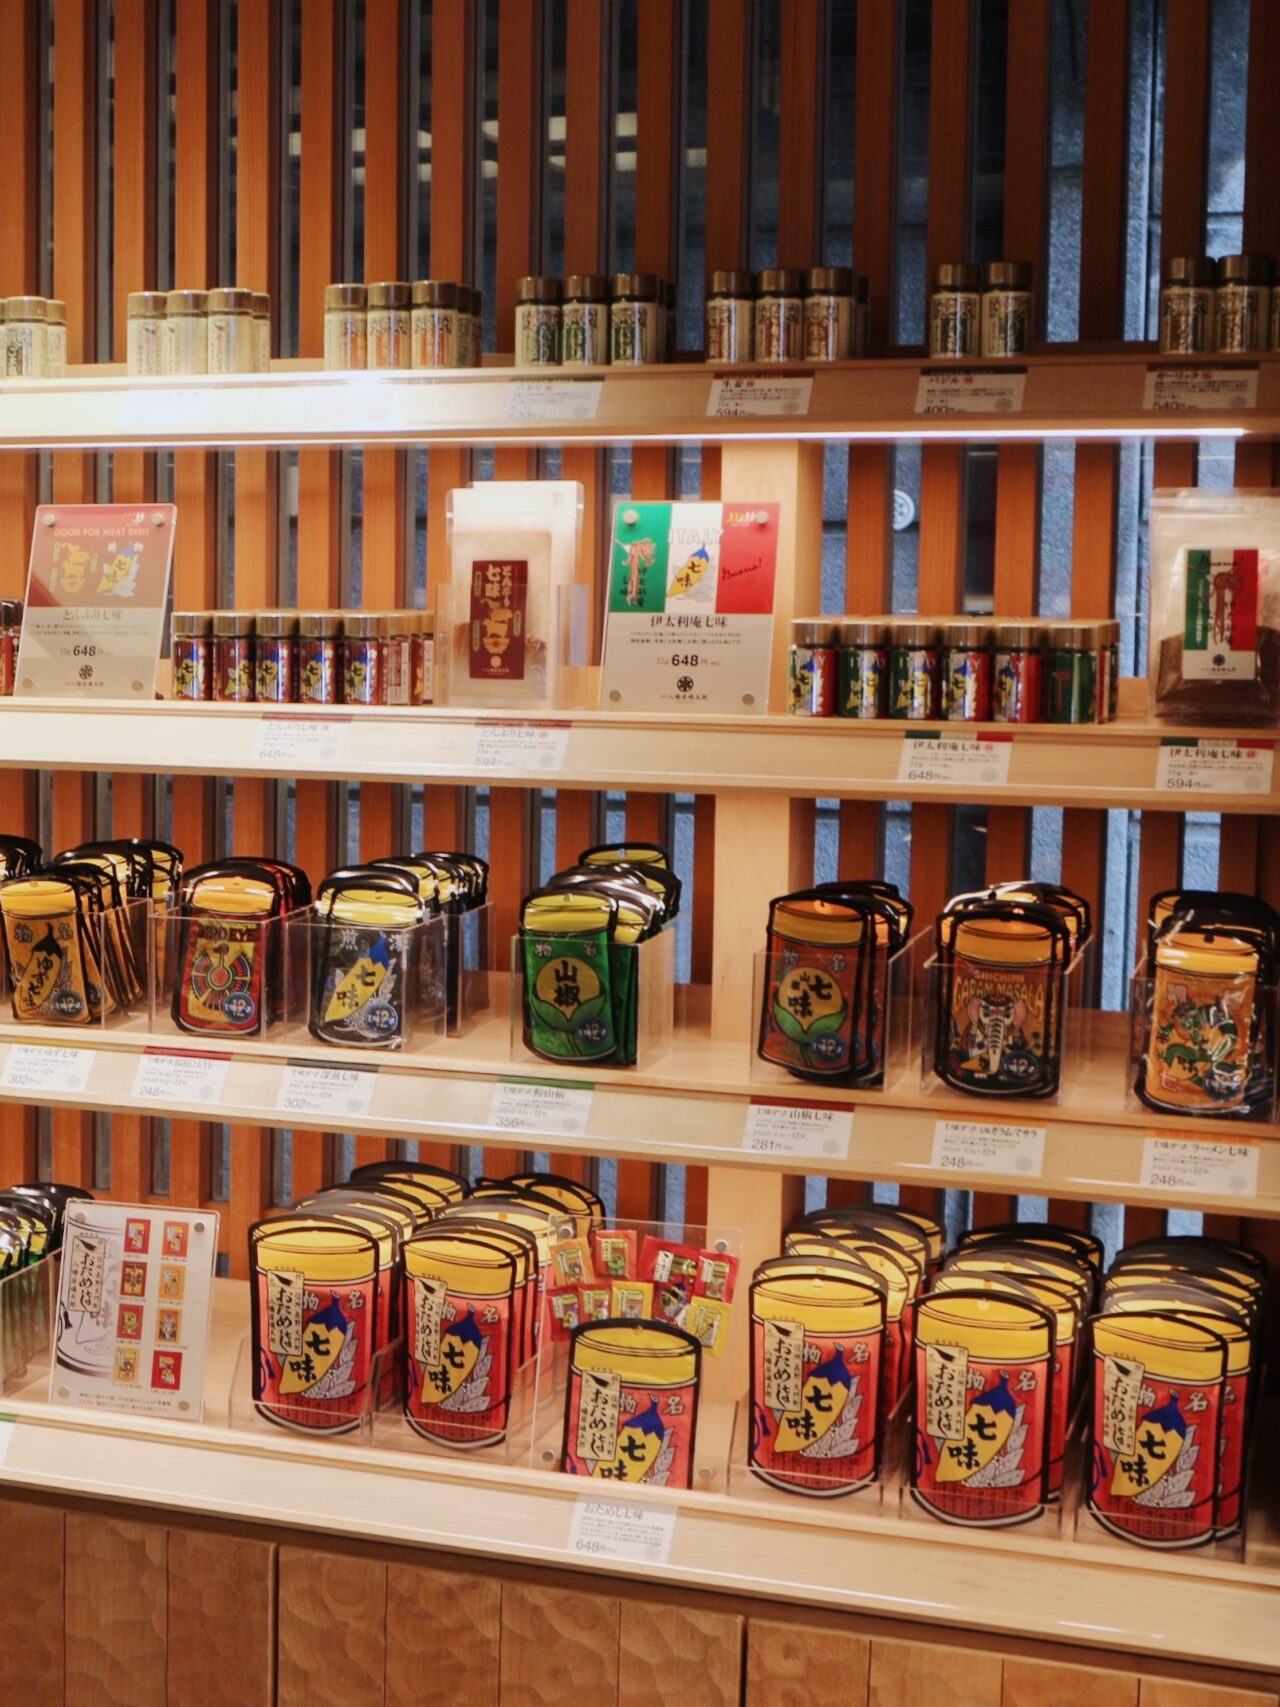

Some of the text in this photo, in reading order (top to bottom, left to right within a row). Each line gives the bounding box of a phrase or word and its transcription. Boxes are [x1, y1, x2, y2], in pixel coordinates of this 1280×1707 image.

[54, 527, 150, 537] GOOD FOR MEAT DISH
[668, 527, 725, 546] ITALY
[485, 563, 502, 598] 七味
[677, 561, 702, 589] 七味
[62, 609, 123, 621] どんぶり七味
[650, 615, 728, 629] 伊太利庵七味
[73, 645, 96, 657] 648
[671, 654, 699, 667] 648
[913, 741, 981, 753] 伊太利庵七味
[1169, 747, 1243, 760] 伊太利庵七味
[24, 957, 53, 1007] ゆず七味
[337, 964, 376, 1010] 七味
[553, 959, 580, 1007] 山椒
[788, 974, 833, 1019] 七味
[789, 1109, 834, 1122] 山椒七味
[1190, 1143, 1250, 1157] ラーメン七味
[347, 1289, 365, 1310] 名
[482, 1303, 500, 1324] 名
[288, 1330, 331, 1384] 七味
[851, 1342, 871, 1363] 名
[429, 1342, 465, 1394] 七味
[1017, 1371, 1037, 1392] 名
[664, 1395, 684, 1416] 名
[1186, 1392, 1208, 1412] 名
[786, 1385, 833, 1441] 七味
[947, 1413, 997, 1471] 七味
[1120, 1429, 1167, 1488] 七味
[583, 1503, 644, 1521] おためし七味
